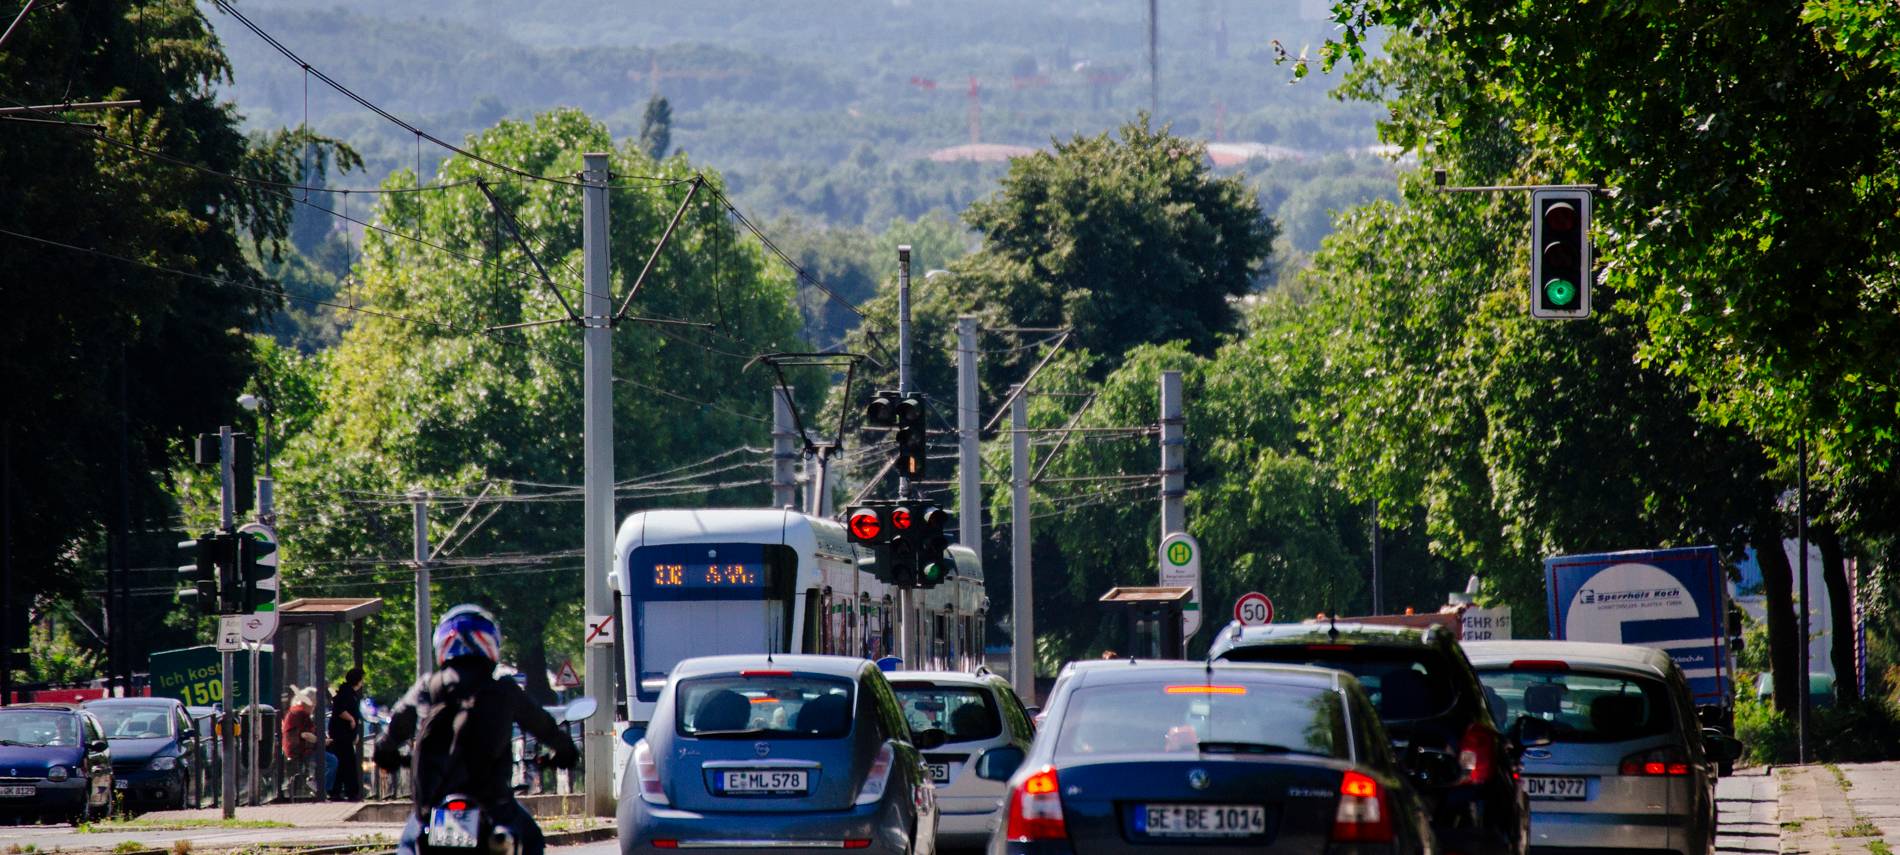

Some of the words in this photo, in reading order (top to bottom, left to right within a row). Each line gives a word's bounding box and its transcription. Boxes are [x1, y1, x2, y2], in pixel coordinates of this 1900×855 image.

[1174, 546, 1186, 560] H
[1597, 591, 1650, 602] Sperrholz
[1654, 588, 1680, 598] Koch
[1243, 604, 1266, 621] 50
[160, 671, 185, 688] Ich
[180, 679, 224, 707] 150
[729, 774, 739, 788] E
[749, 774, 769, 788] ML
[772, 773, 800, 788] 578
[1528, 779, 1546, 794] DW
[1550, 779, 1584, 794] 1977
[1148, 808, 1171, 830] GE
[1185, 808, 1209, 830] BE
[1215, 808, 1263, 831] 1014
